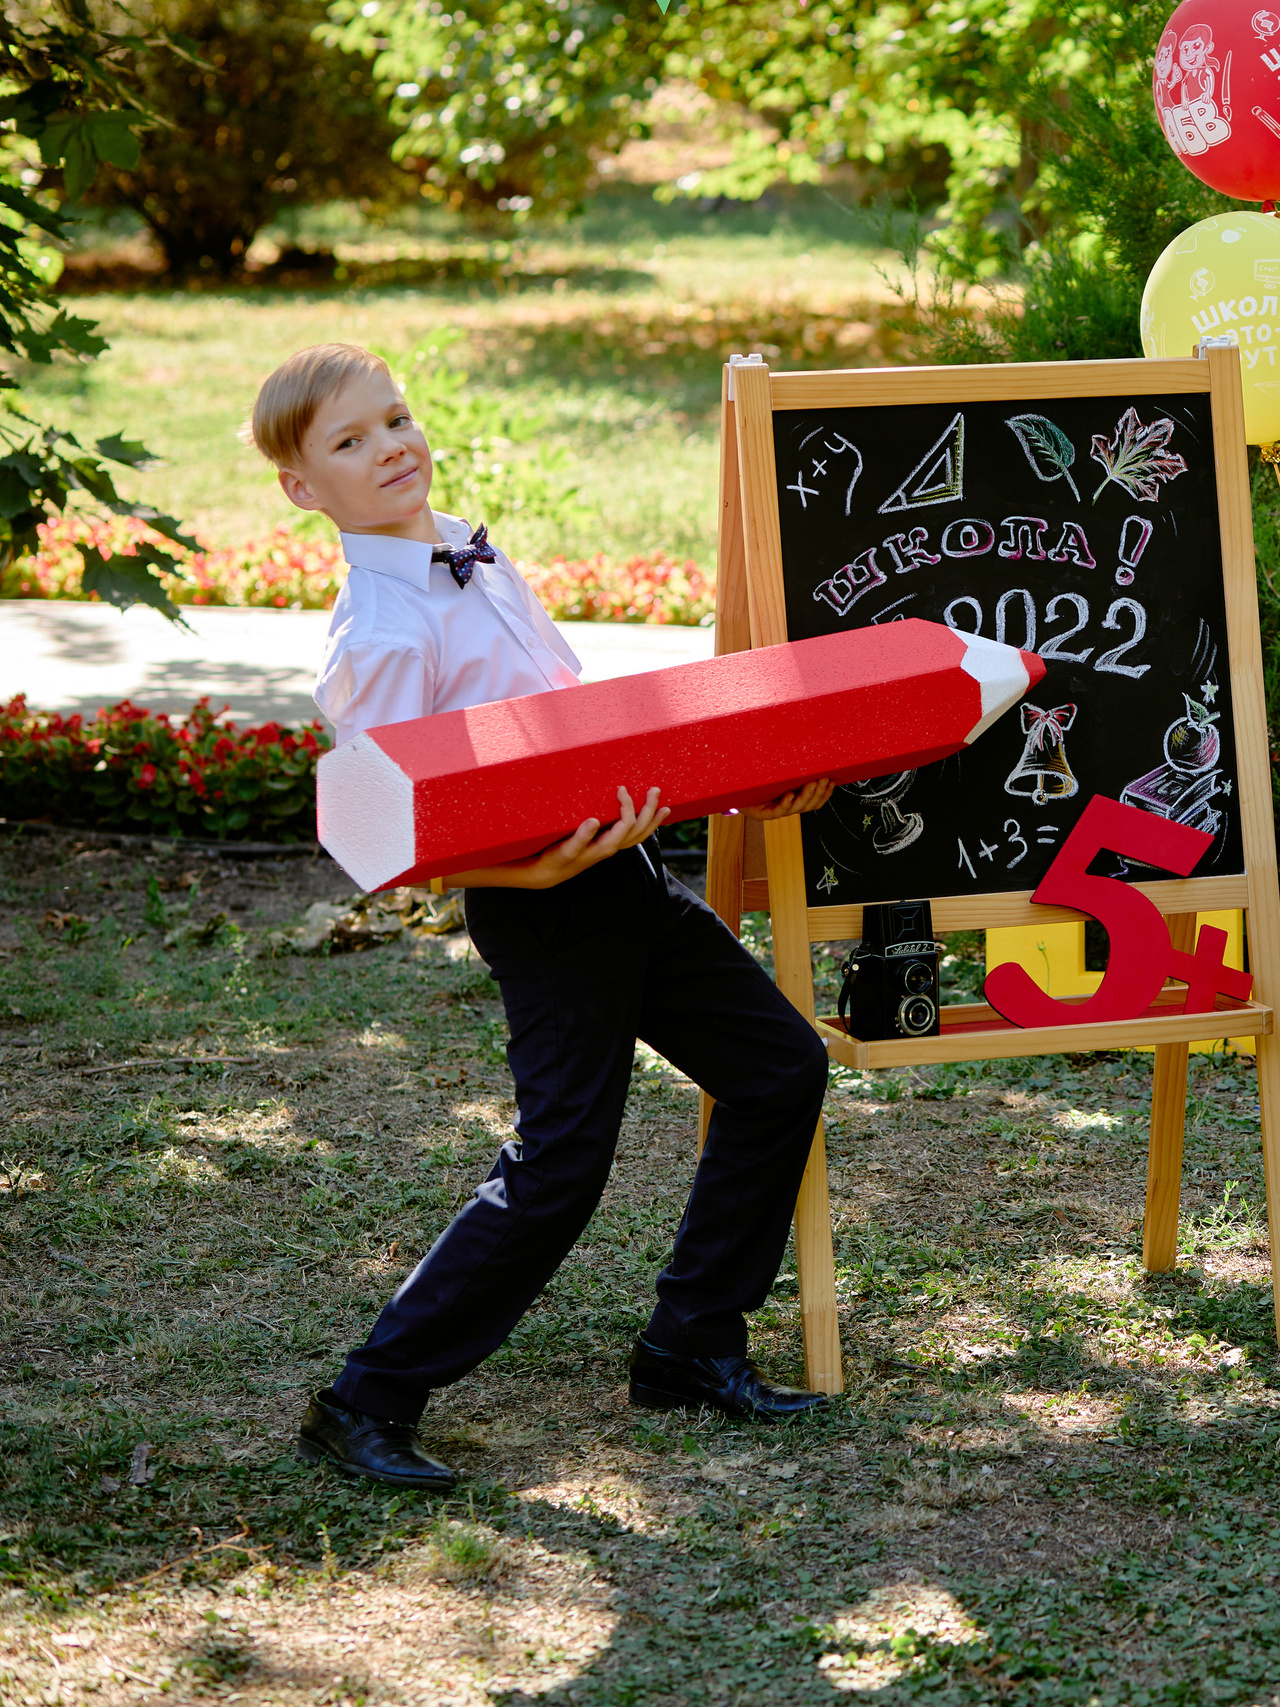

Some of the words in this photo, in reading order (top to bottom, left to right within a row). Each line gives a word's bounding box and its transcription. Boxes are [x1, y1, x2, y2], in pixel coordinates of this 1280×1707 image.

[1163, 96, 1232, 157] АБВ
[943, 588, 1151, 679] 2022
[922, 943, 929, 952] 2
